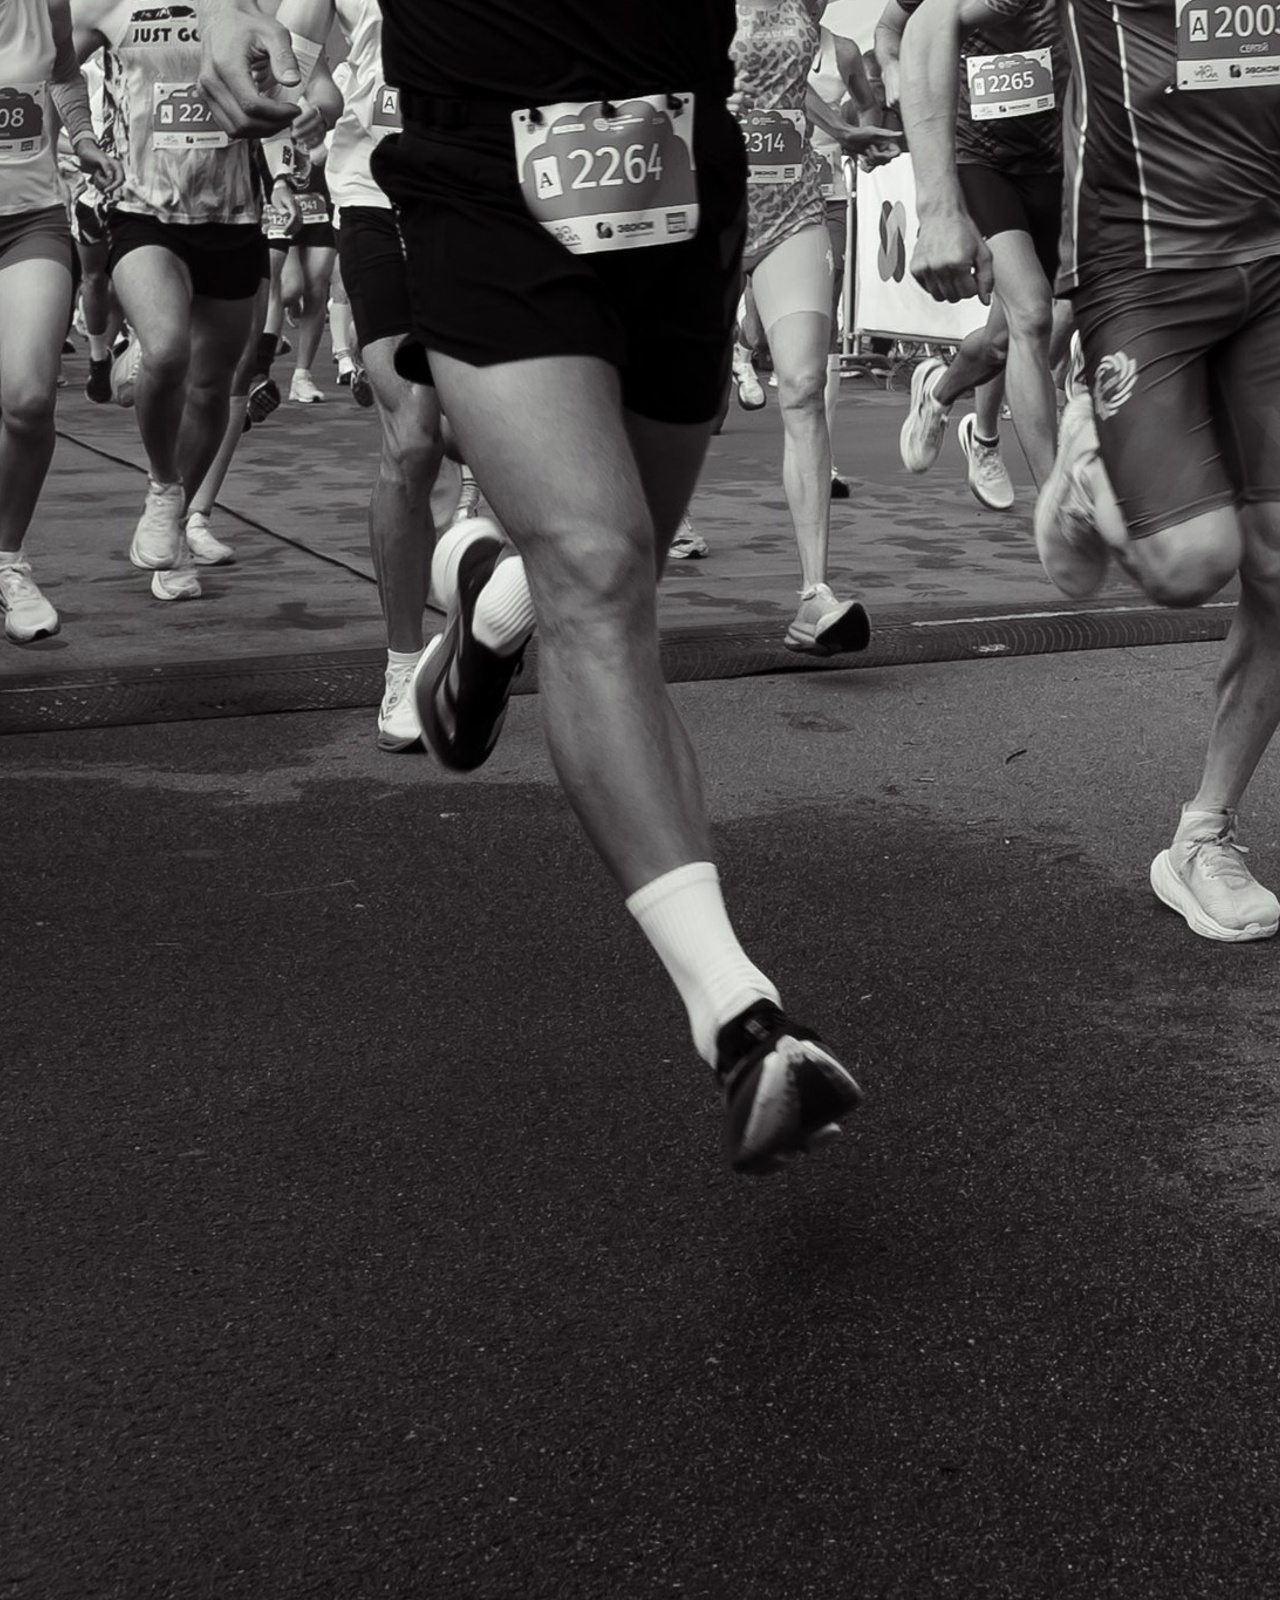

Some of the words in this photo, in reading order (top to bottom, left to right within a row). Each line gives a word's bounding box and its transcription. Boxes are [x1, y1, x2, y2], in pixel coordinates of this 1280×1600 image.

[133, 27, 172, 43] JUST
[1192, 16, 1206, 36] A
[988, 70, 1035, 93] 2265
[384, 95, 395, 110] A
[179, 103, 212, 122] 22
[540, 171, 554, 189] A
[567, 142, 663, 190] 2264
